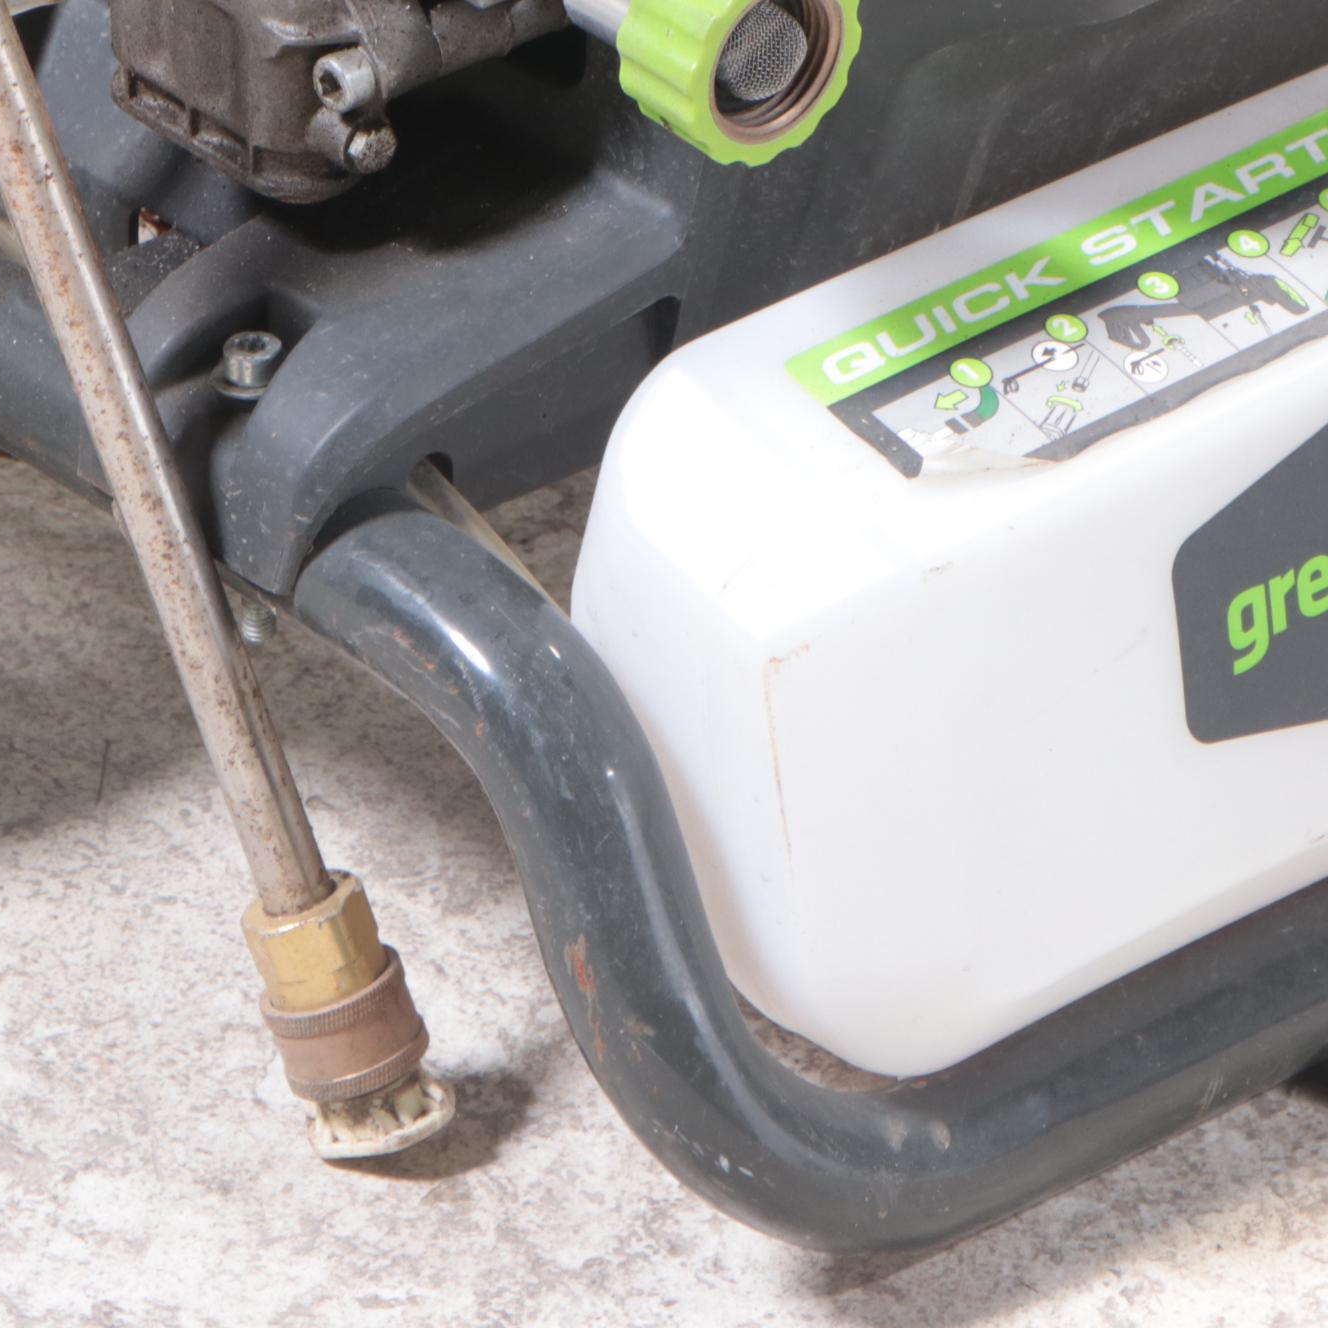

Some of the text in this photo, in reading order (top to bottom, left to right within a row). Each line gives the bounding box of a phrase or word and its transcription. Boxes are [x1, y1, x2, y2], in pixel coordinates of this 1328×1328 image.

[1237, 232, 1259, 252] 4
[1147, 275, 1169, 295] 3
[822, 257, 1066, 384] QUICK
[1053, 318, 1077, 337] 2
[957, 363, 979, 381] 1
